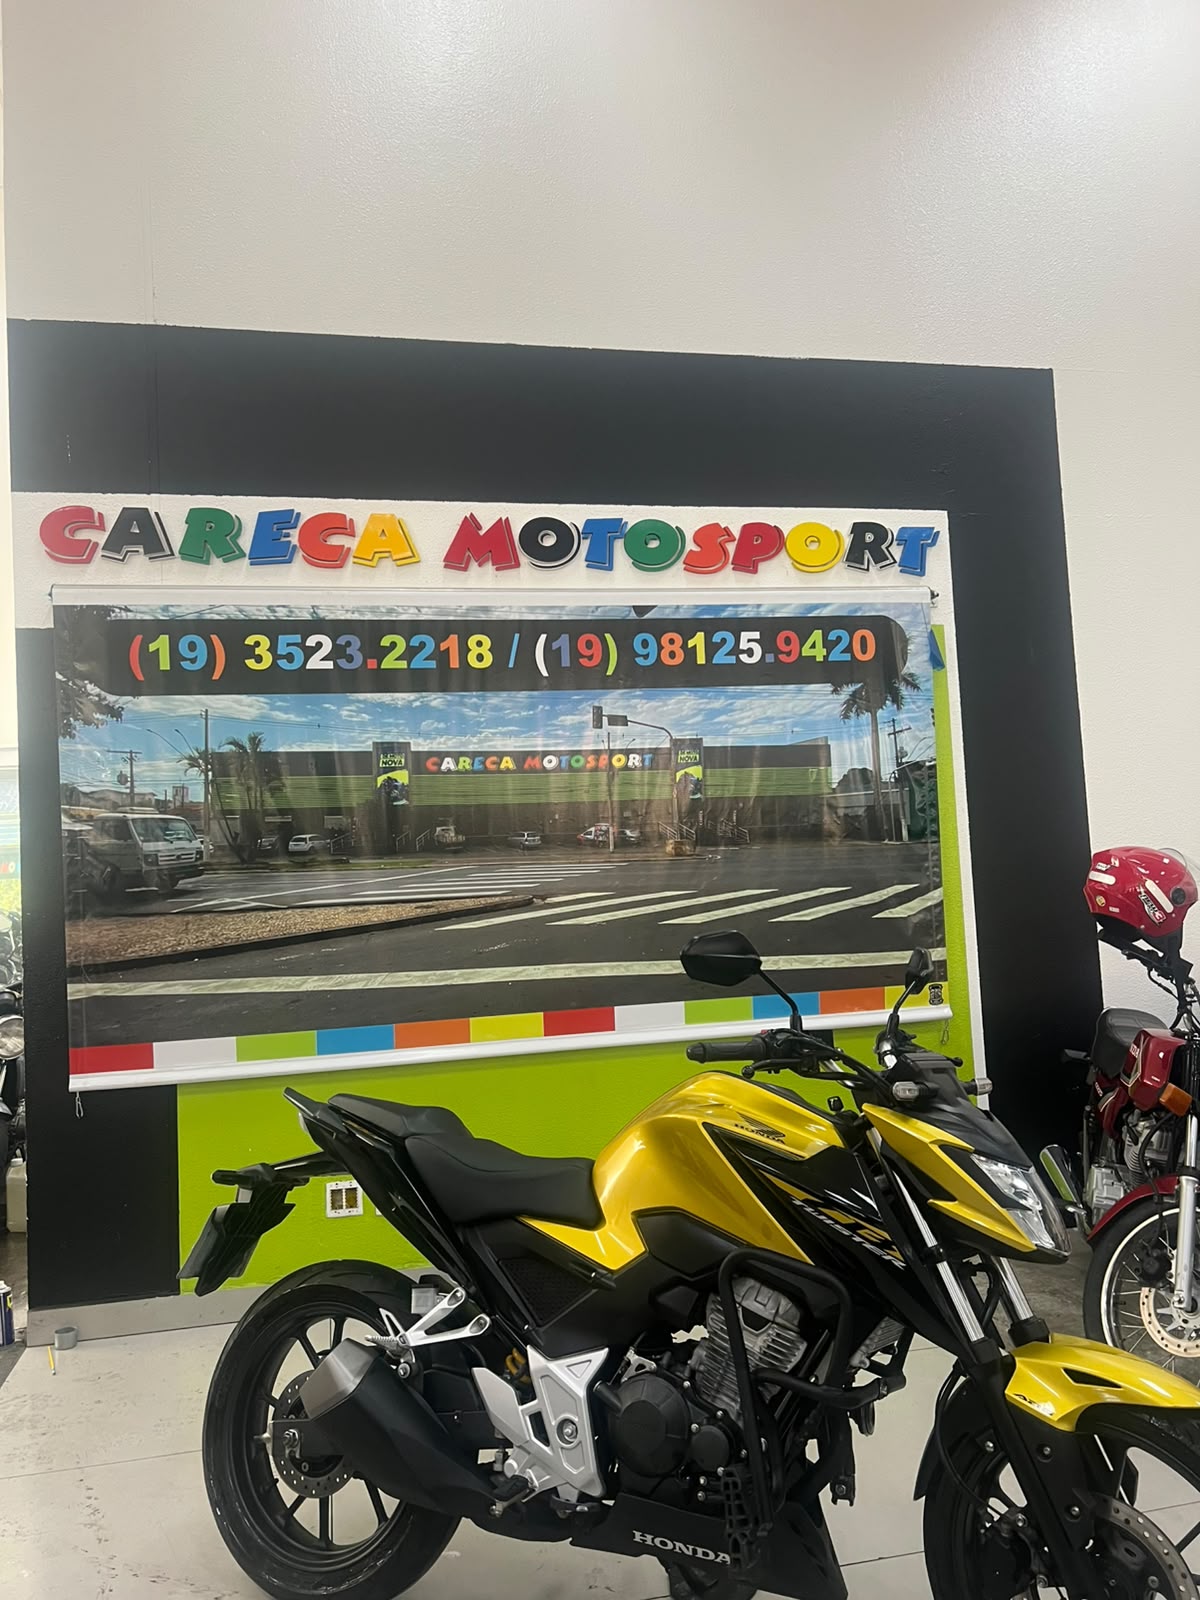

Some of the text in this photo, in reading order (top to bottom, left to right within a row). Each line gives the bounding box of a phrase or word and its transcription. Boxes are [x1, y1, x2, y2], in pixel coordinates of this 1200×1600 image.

[39, 505, 940, 576] CARECA MOTOSPORT
[129, 628, 876, 681] (19) 3523.2218 / (19) 98125.9420
[425, 753, 655, 772] CARECA MOTOSPORT
[734, 1123, 786, 1145] HONDA
[790, 1196, 907, 1271] TWISTER
[632, 1530, 731, 1566] HONDA
